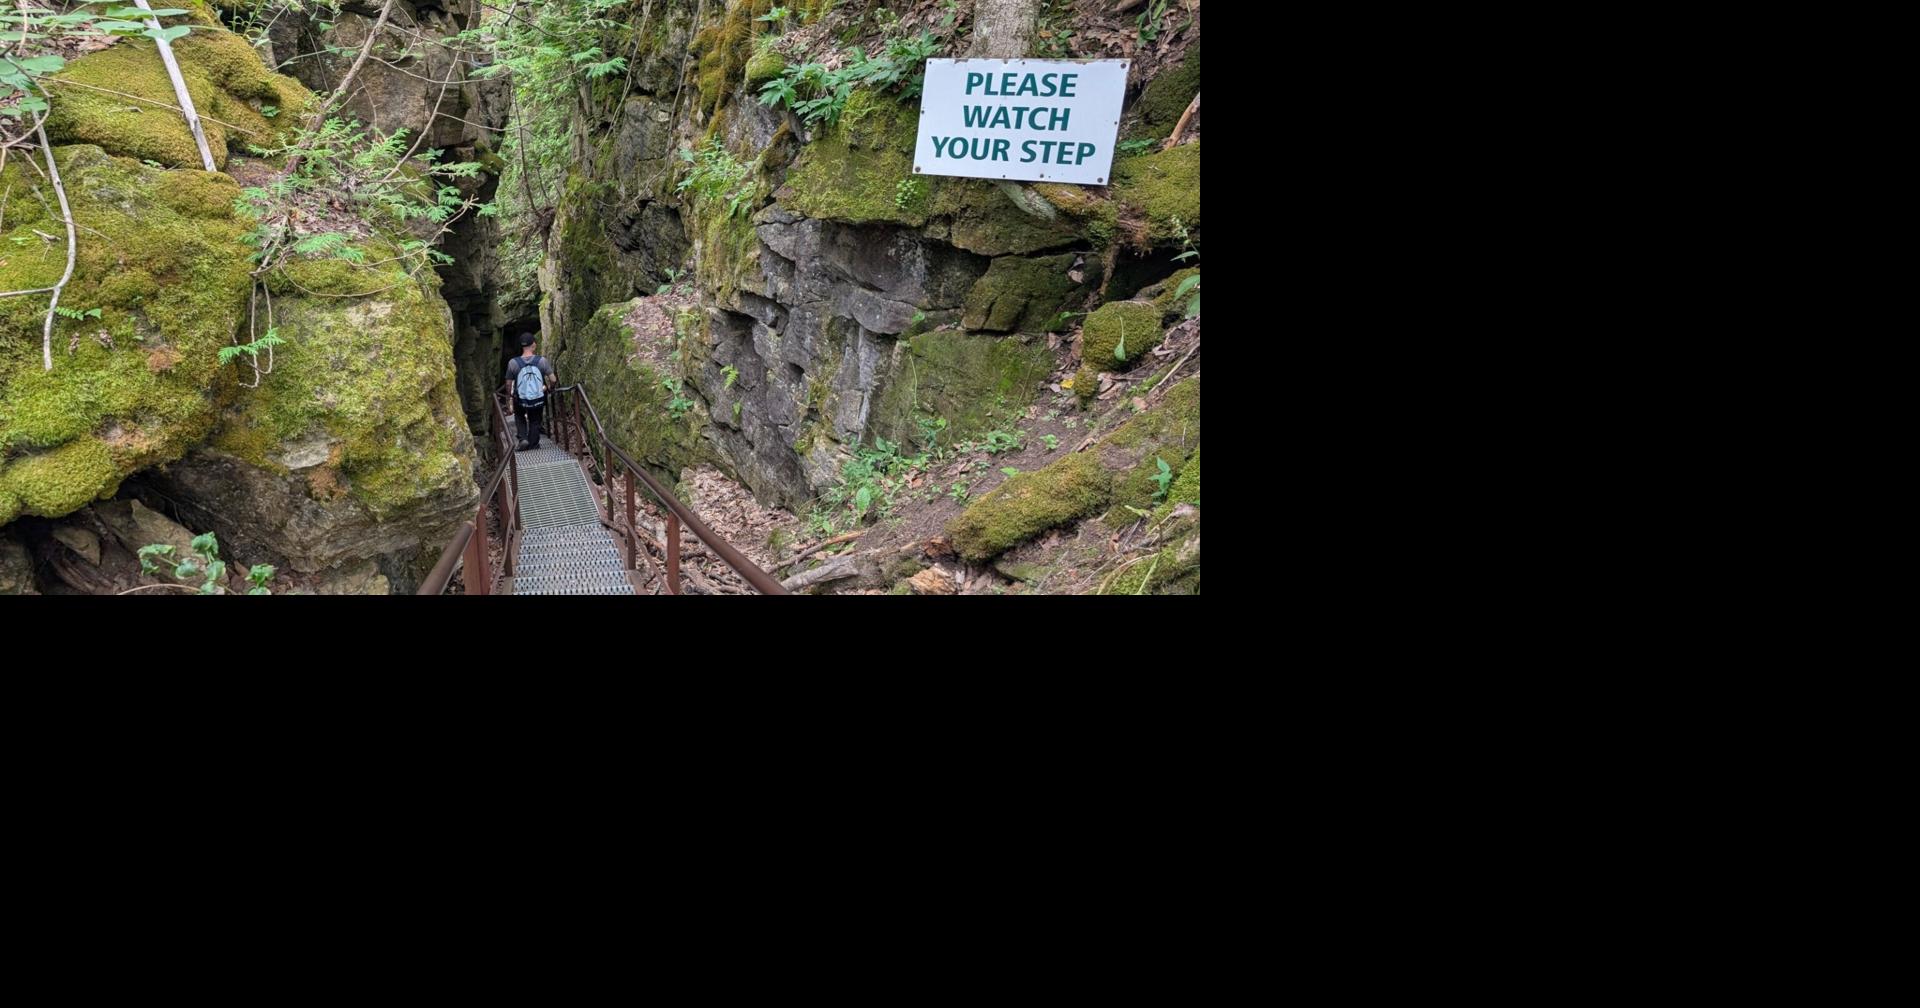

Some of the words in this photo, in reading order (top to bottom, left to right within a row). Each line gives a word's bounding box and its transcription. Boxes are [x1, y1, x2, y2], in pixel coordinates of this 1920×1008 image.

[965, 72, 1078, 97] PLEASE
[963, 105, 1071, 131] WATCH
[931, 136, 1011, 162] YOUR
[1020, 139, 1096, 165] STEP
